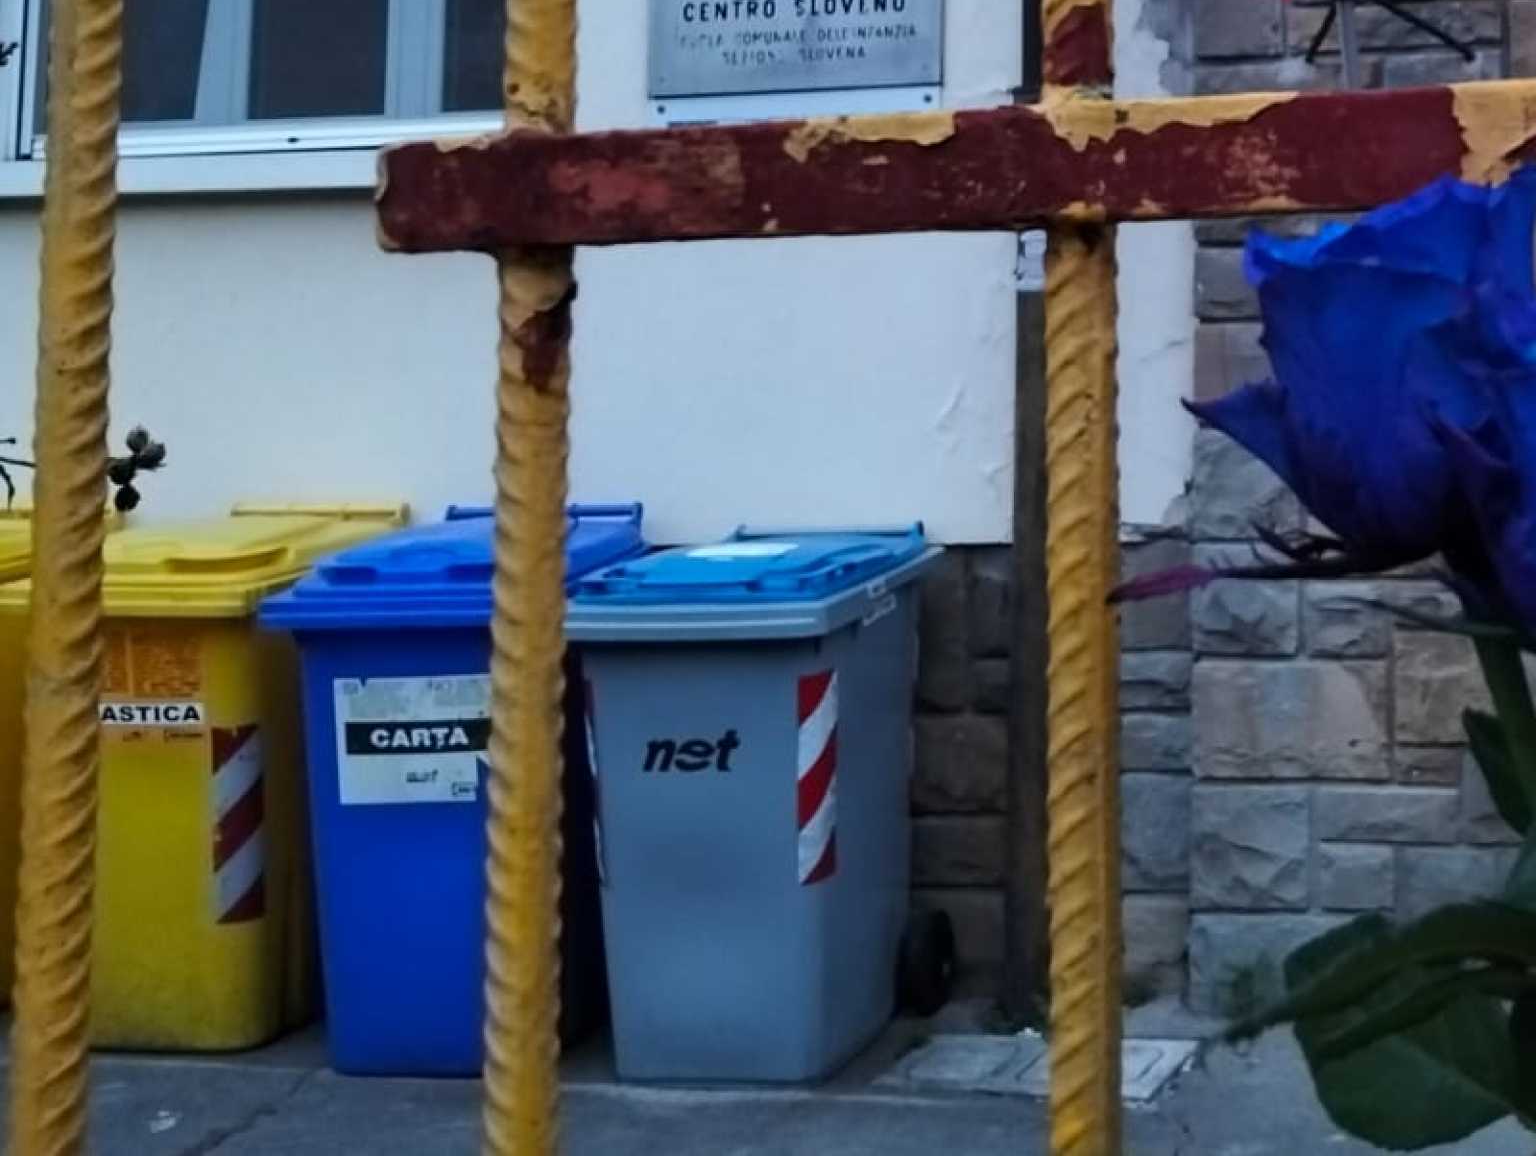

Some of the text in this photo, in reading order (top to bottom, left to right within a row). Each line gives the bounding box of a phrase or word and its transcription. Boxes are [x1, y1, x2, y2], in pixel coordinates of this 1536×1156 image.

[101, 705, 201, 722] ASTICA
[369, 727, 469, 749] CARTA
[642, 729, 741, 773] net
